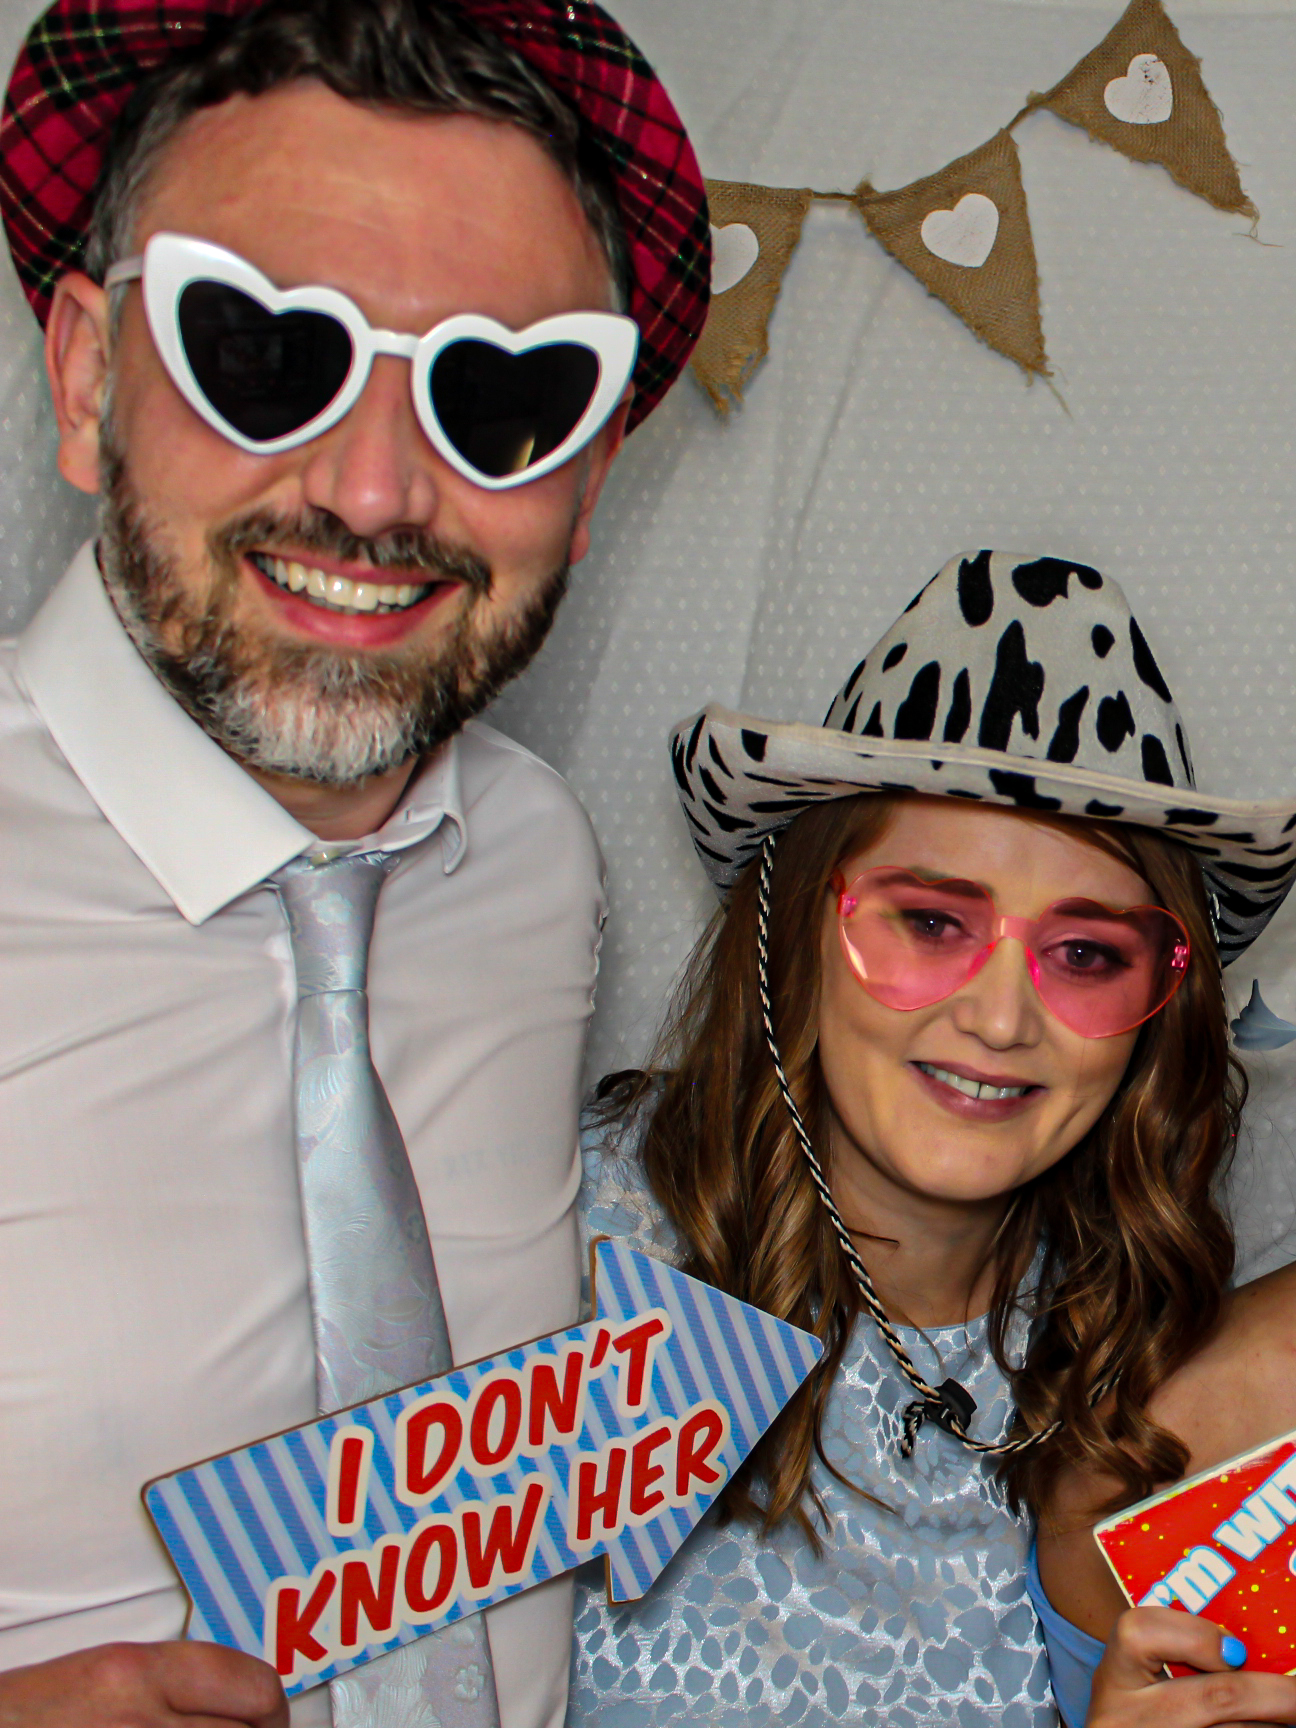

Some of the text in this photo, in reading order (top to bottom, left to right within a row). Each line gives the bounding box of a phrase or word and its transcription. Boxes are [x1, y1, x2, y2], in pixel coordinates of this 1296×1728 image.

[336, 1317, 665, 1525] I DON'T
[275, 1408, 724, 1676] KNOW HER
